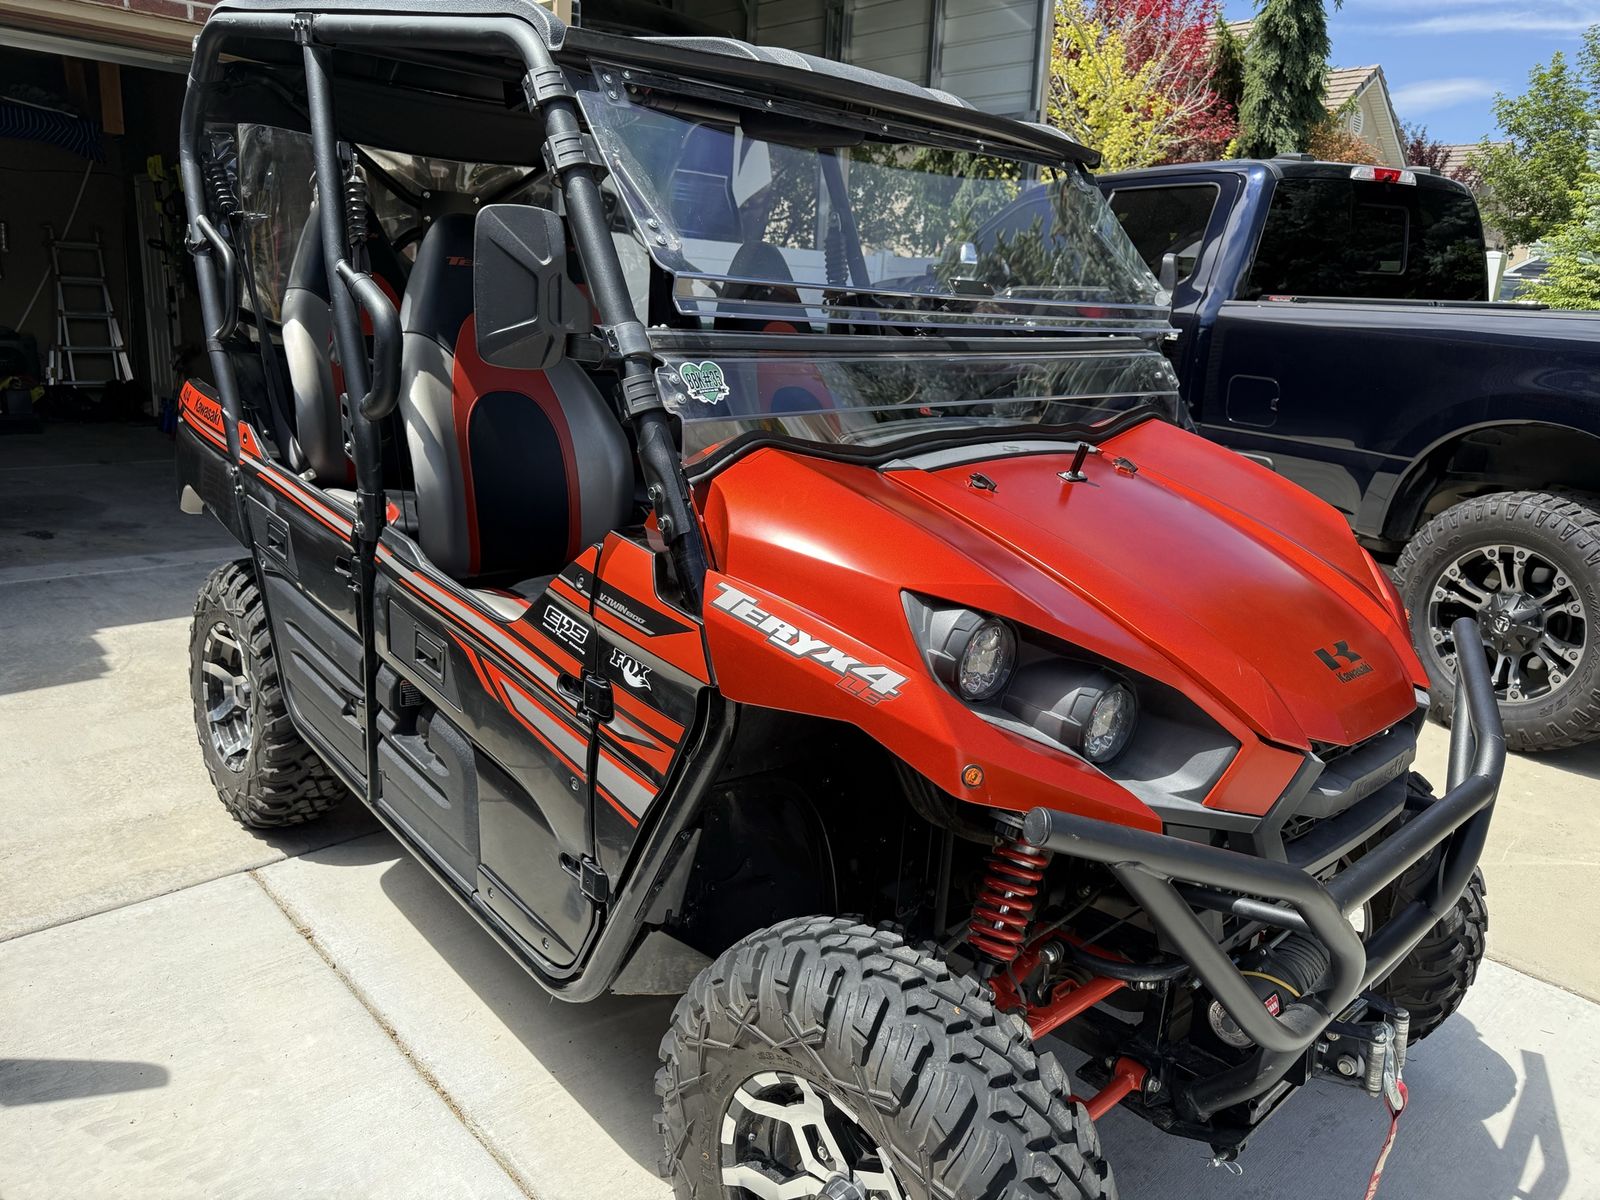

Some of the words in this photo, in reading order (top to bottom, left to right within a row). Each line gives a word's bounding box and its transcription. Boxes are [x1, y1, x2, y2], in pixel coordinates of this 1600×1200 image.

[194, 396, 221, 426] Kawasaki
[544, 604, 589, 644] EPS
[609, 647, 652, 688] FOX
[1335, 660, 1375, 684] Kawasaki
